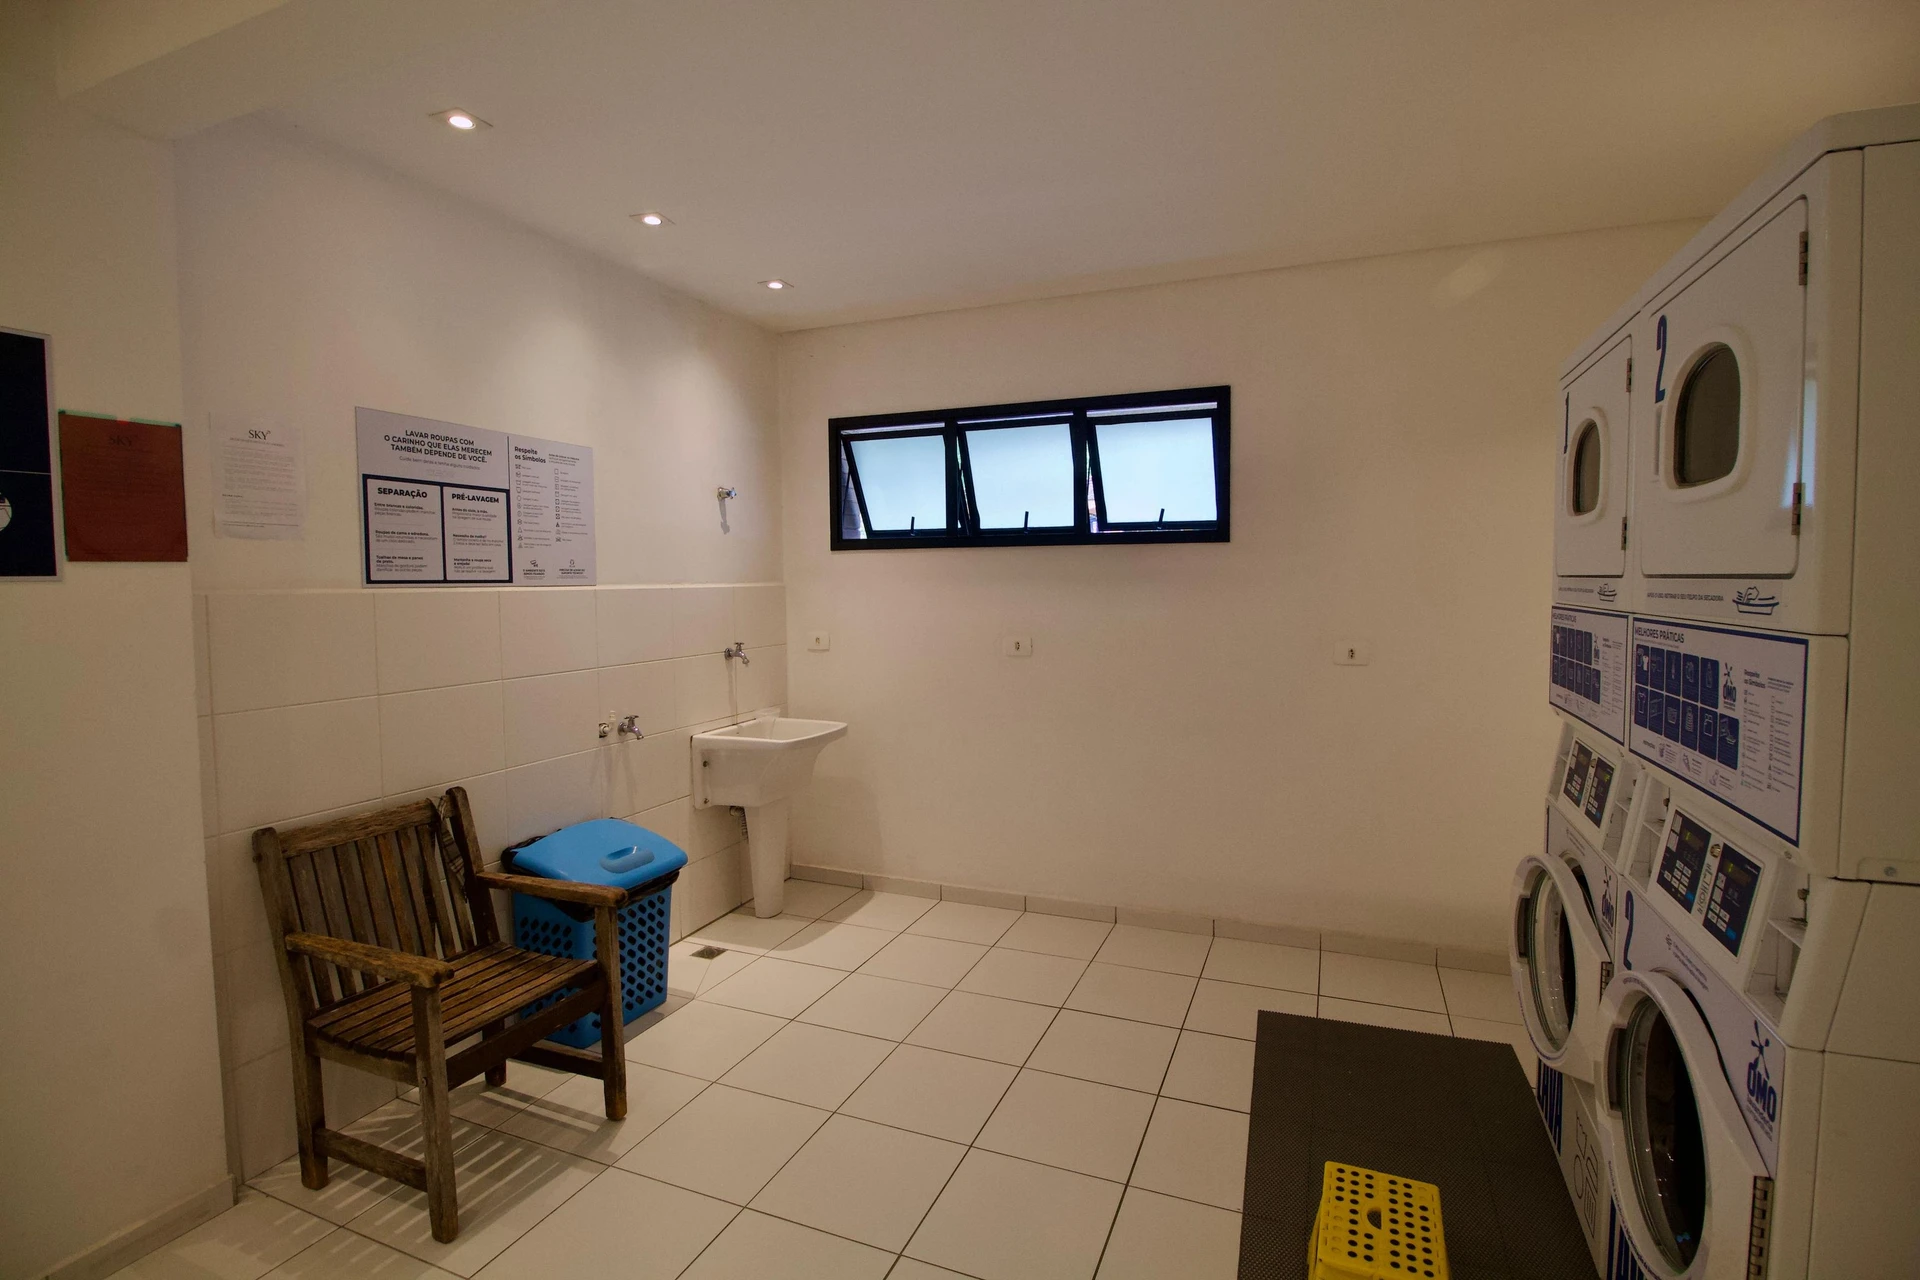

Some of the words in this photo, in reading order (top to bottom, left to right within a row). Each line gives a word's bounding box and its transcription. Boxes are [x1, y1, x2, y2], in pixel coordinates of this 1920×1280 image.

[1655, 314, 1667, 404] 2
[248, 429, 268, 440] SKY
[405, 430, 429, 440] LAVAR
[430, 433, 458, 444] ROUPAS
[459, 438, 474, 446] COM
[384, 434, 390, 442] O
[392, 436, 426, 447] CARINHO
[427, 441, 442, 449] QUE
[443, 443, 460, 452] ELAS
[461, 446, 493, 456] MERECEM
[390, 443, 423, 454] TAMBÉM
[424, 448, 456, 459] DEPENDE
[469, 454, 488, 463] VOCÊ.
[515, 446, 538, 455] Respeite
[522, 454, 546, 463] Símbolos
[377, 487, 428, 499] SEPARAÇÃO
[451, 493, 499, 503] PRÉ-LAVAGEM
[1634, 627, 1659, 639] MELHORES
[1660, 629, 1685, 643] PRÁTICAS
[1623, 890, 1634, 970] 2
[1747, 1061, 1777, 1123] OMO
